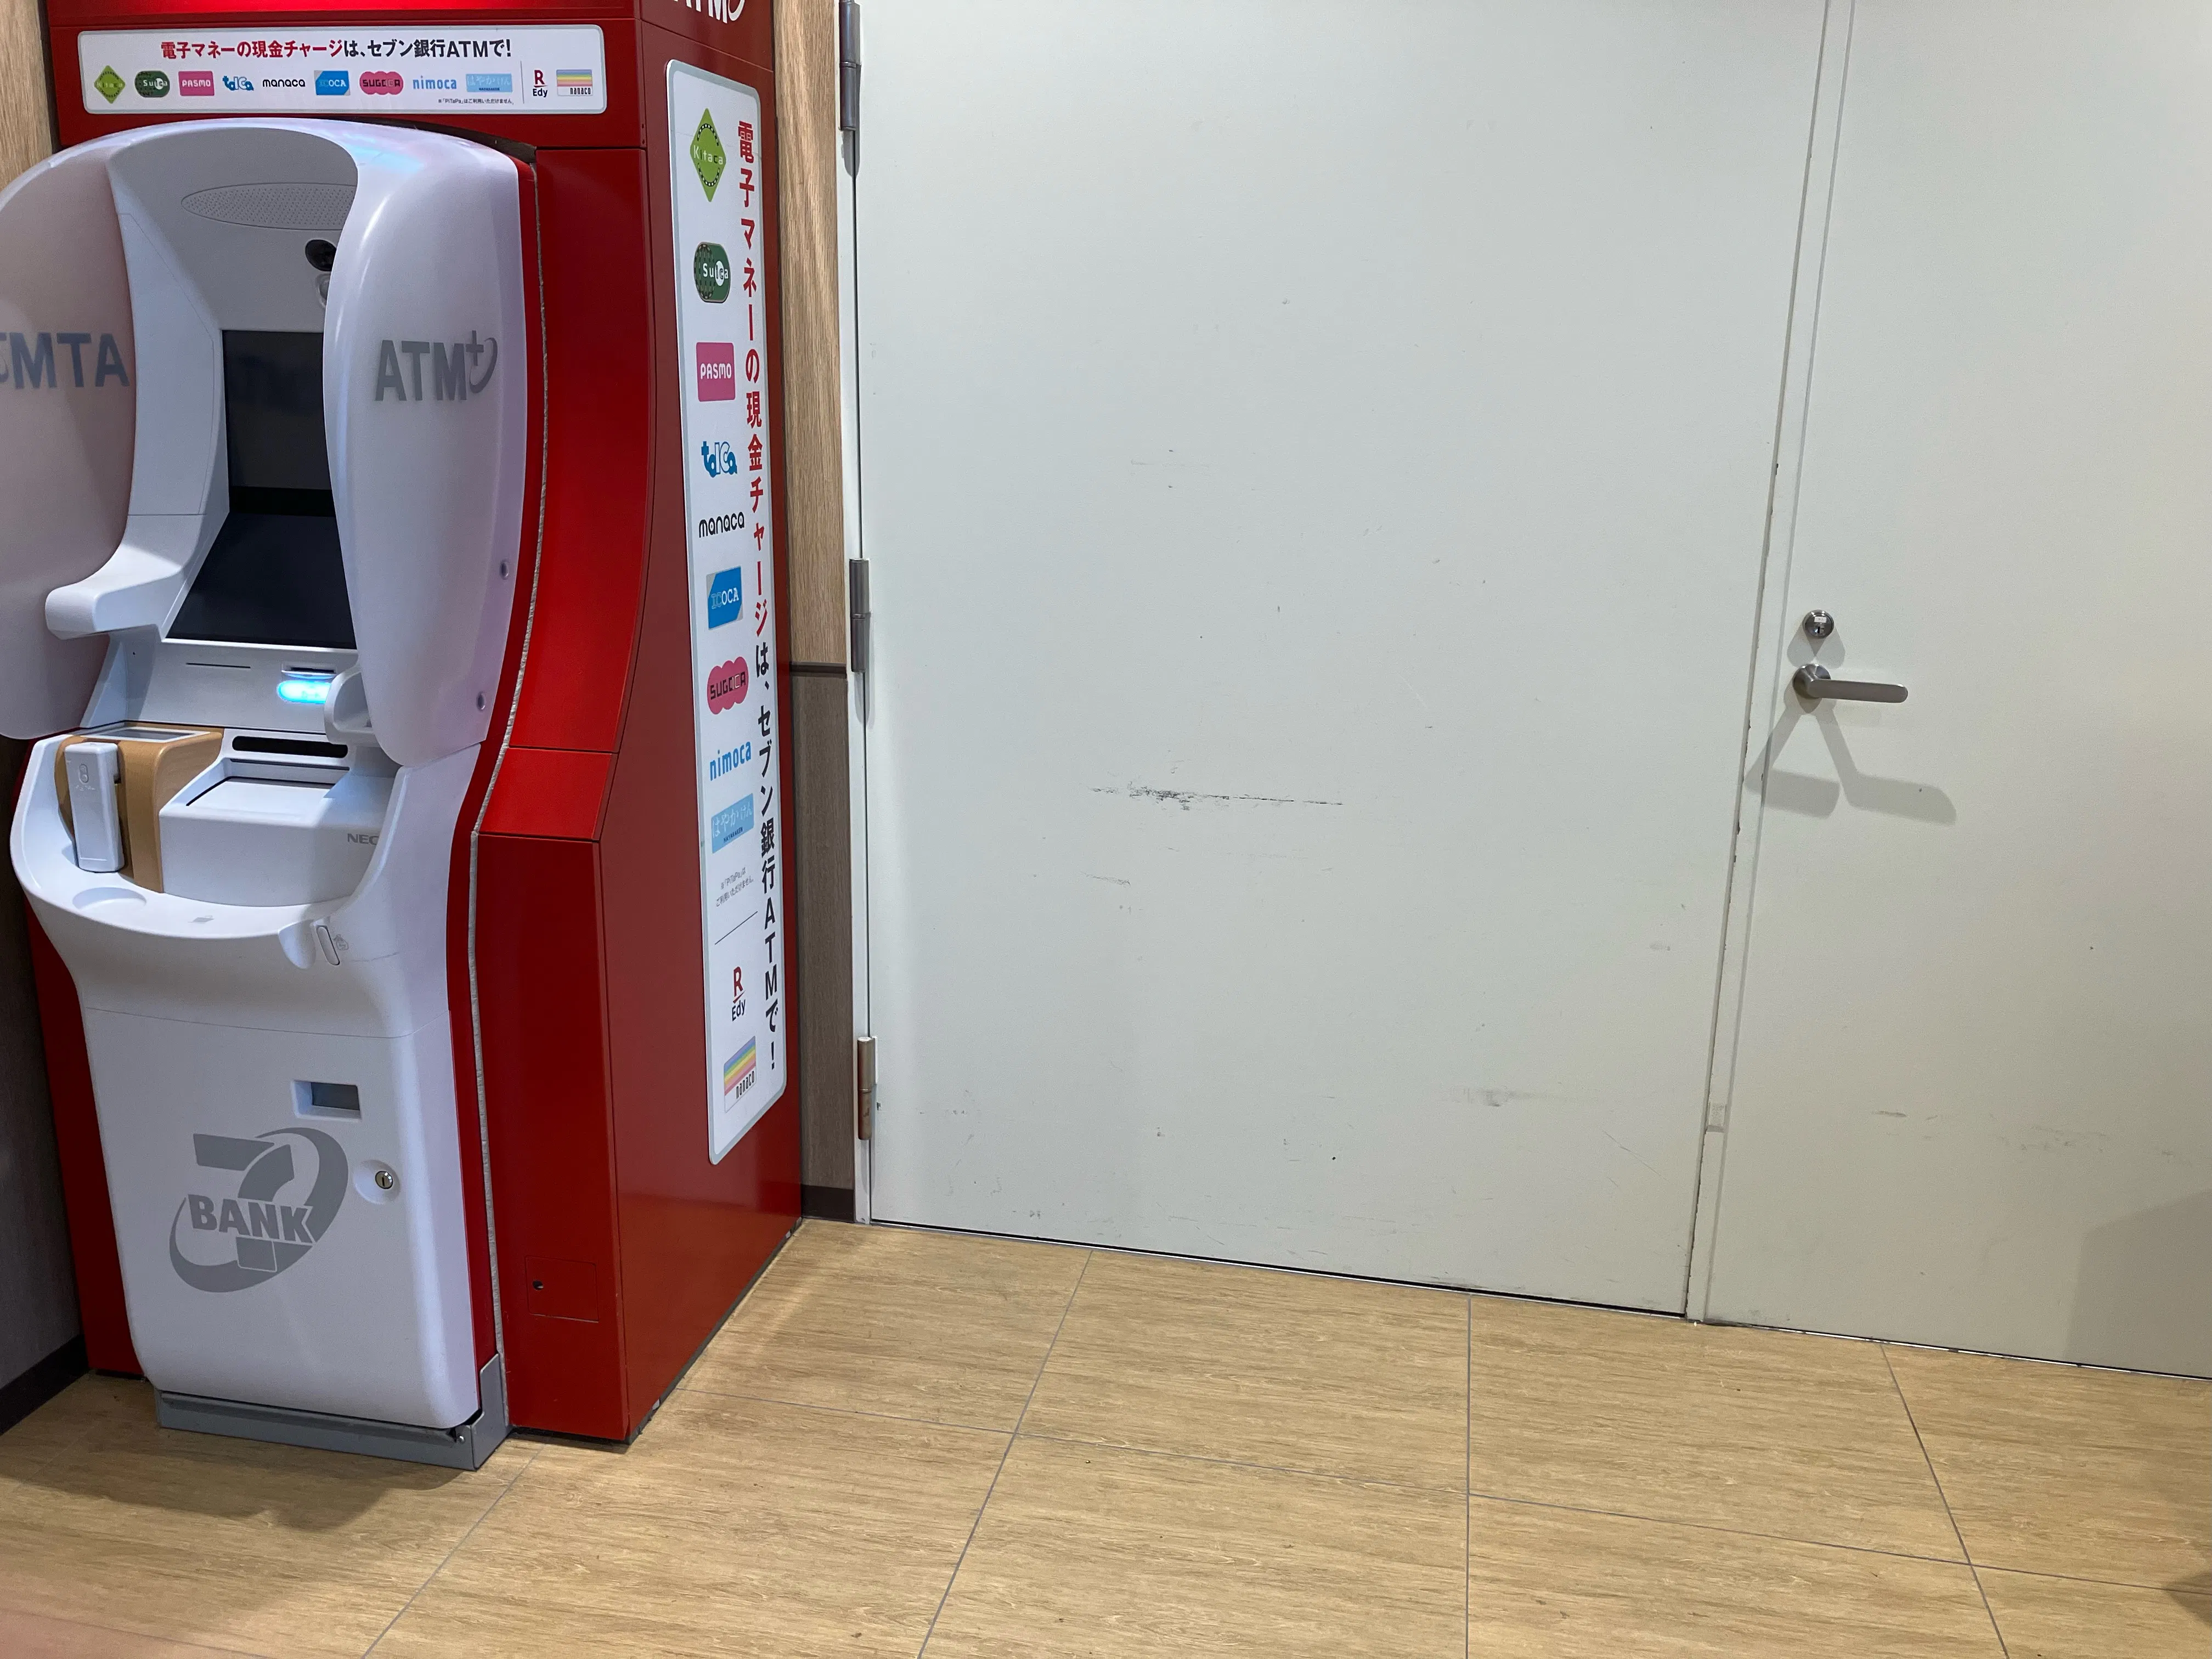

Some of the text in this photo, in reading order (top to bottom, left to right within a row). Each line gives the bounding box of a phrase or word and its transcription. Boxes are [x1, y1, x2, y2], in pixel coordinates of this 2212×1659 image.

[143, 78, 168, 89] Suica
[182, 79, 211, 88] PASMO
[262, 79, 306, 87] manaca
[413, 75, 457, 90] nimoca
[532, 88, 548, 98] Edy
[693, 144, 724, 165] Kitaca
[703, 263, 729, 281] Suica
[700, 363, 732, 380] PASMO
[698, 511, 745, 538] manaca
[711, 587, 739, 610] ICOCA
[710, 671, 746, 700] SUGOCA
[709, 741, 752, 781] nimoca
[347, 833, 380, 845] NEC
[732, 999, 746, 1022] Edy
[736, 1070, 755, 1099] nanaco
[187, 1193, 314, 1244] BANK
